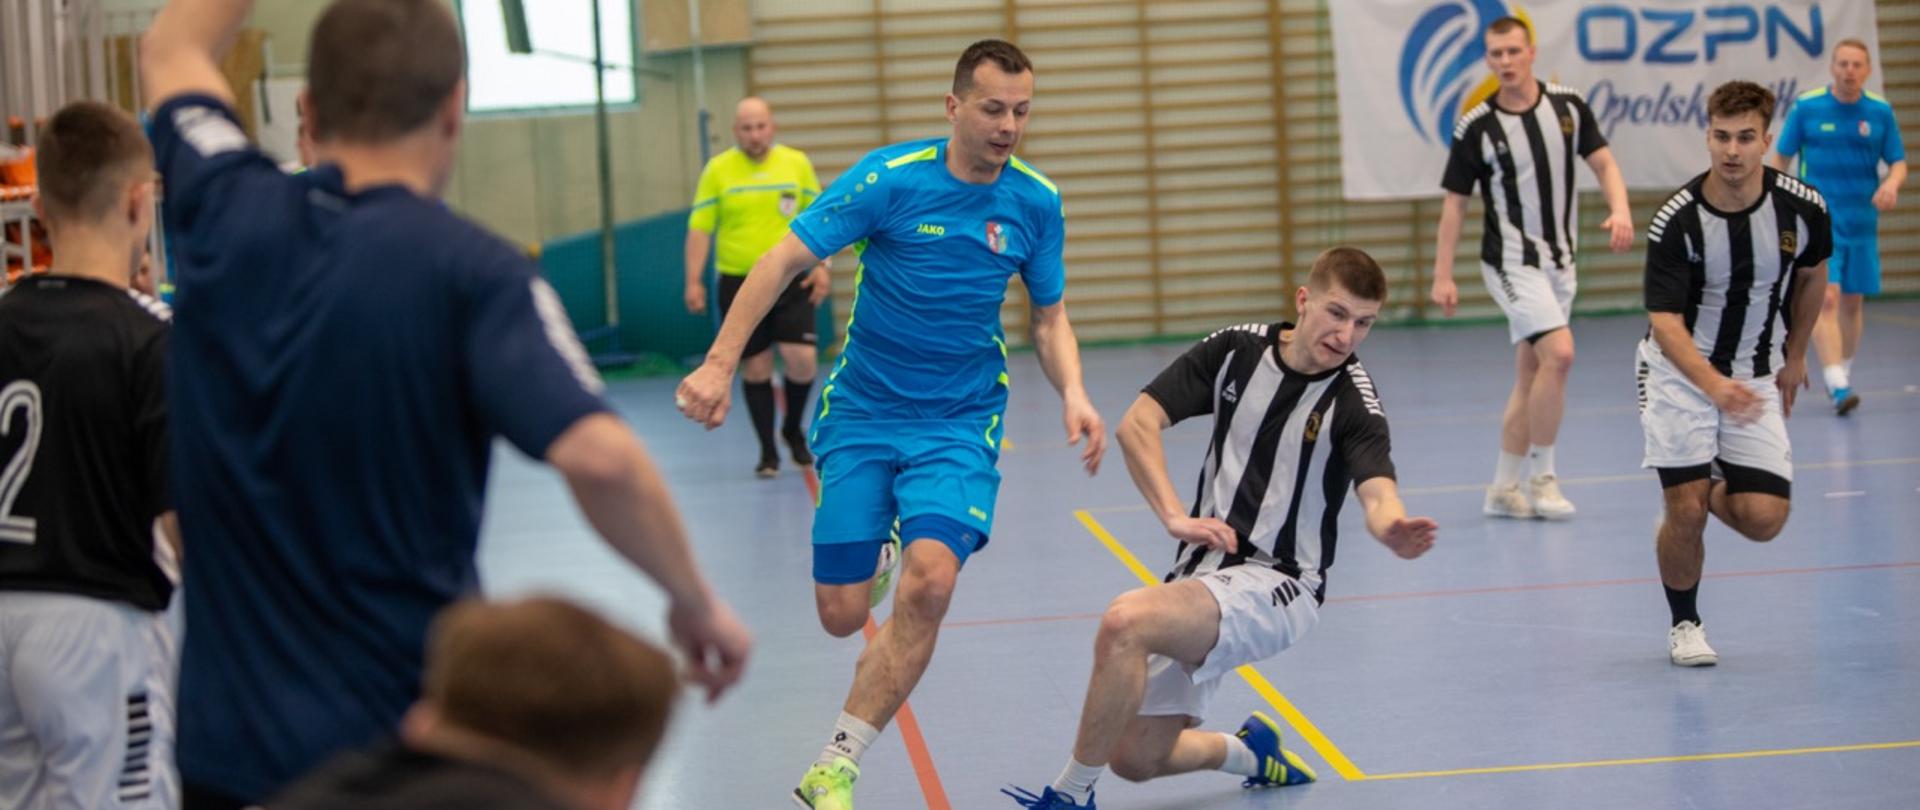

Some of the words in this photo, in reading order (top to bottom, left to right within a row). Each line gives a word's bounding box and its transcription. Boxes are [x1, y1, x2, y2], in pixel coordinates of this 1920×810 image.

[1576, 4, 1824, 63] OZPN
[1587, 79, 1709, 140] Opolsk
[917, 223, 945, 236] JAKO
[0, 379, 43, 544] 2
